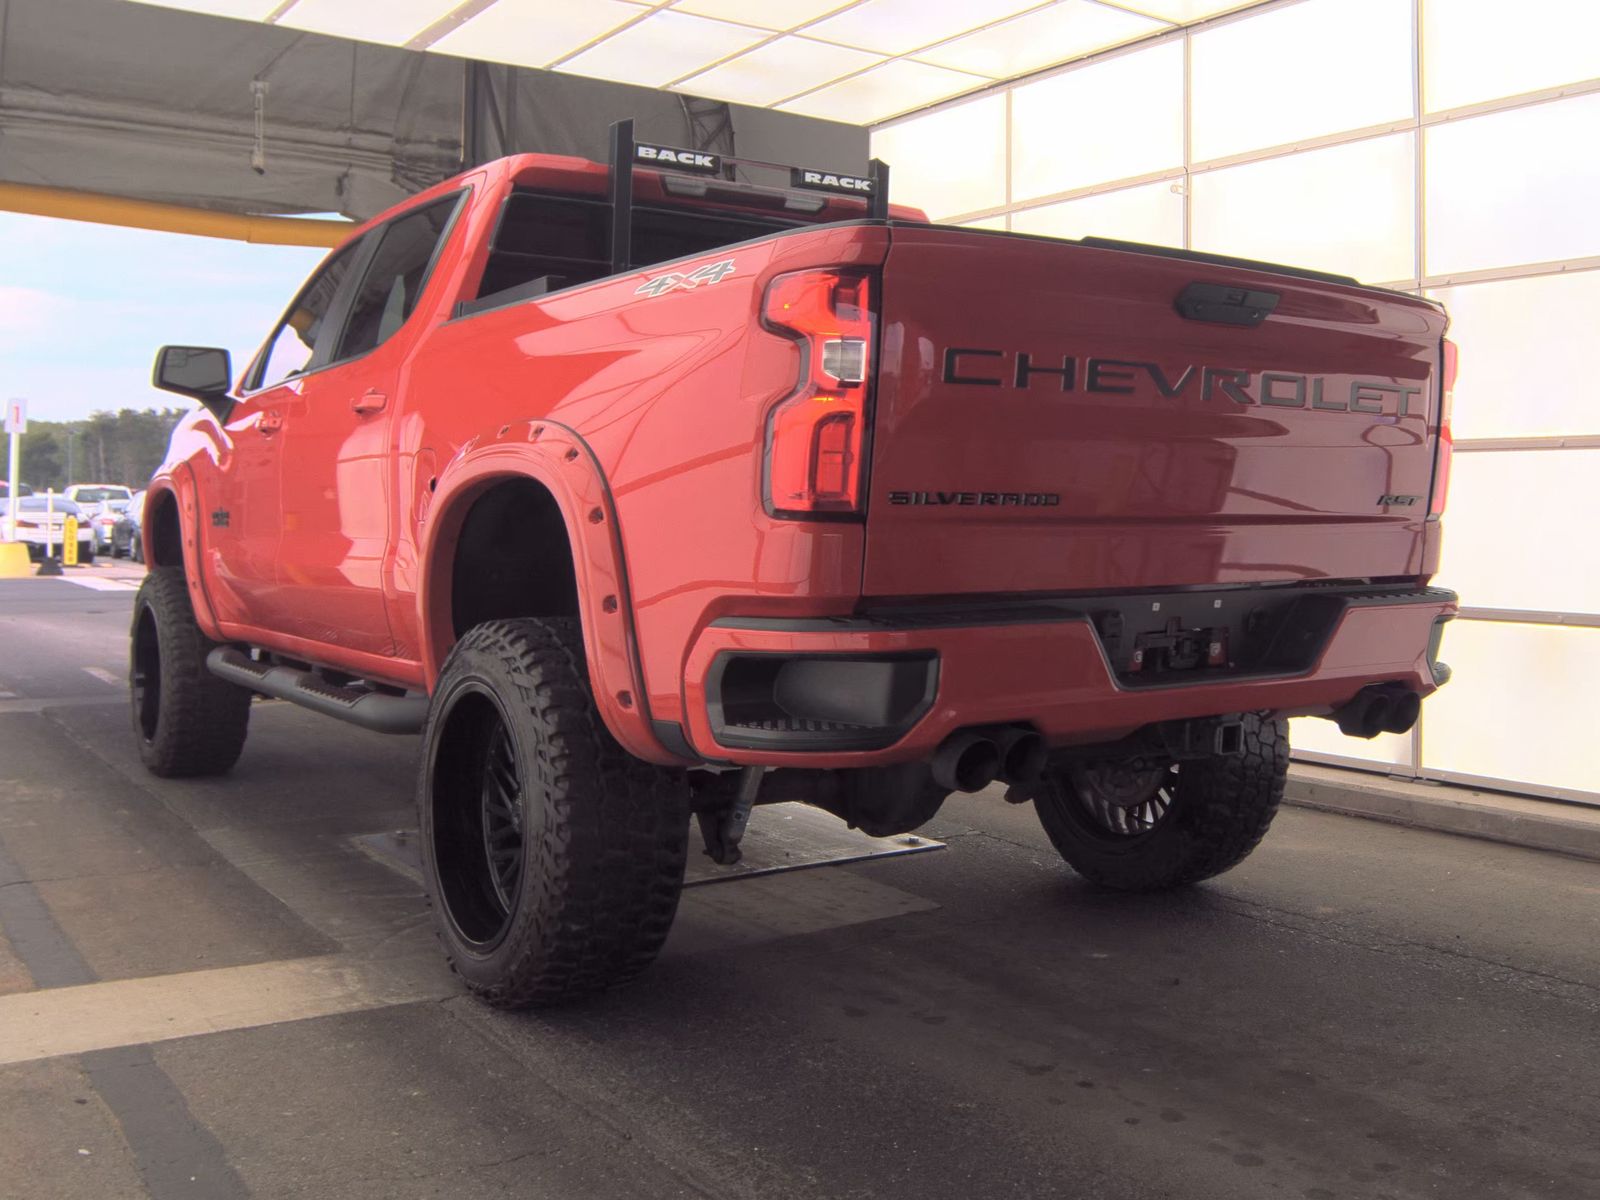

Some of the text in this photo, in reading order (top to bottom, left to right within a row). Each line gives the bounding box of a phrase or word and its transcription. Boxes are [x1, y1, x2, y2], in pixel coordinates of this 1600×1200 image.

[637, 146, 872, 191] BACK RACK
[941, 346, 1422, 417] CHEVROLET
[889, 491, 1060, 506] SILVERADO
